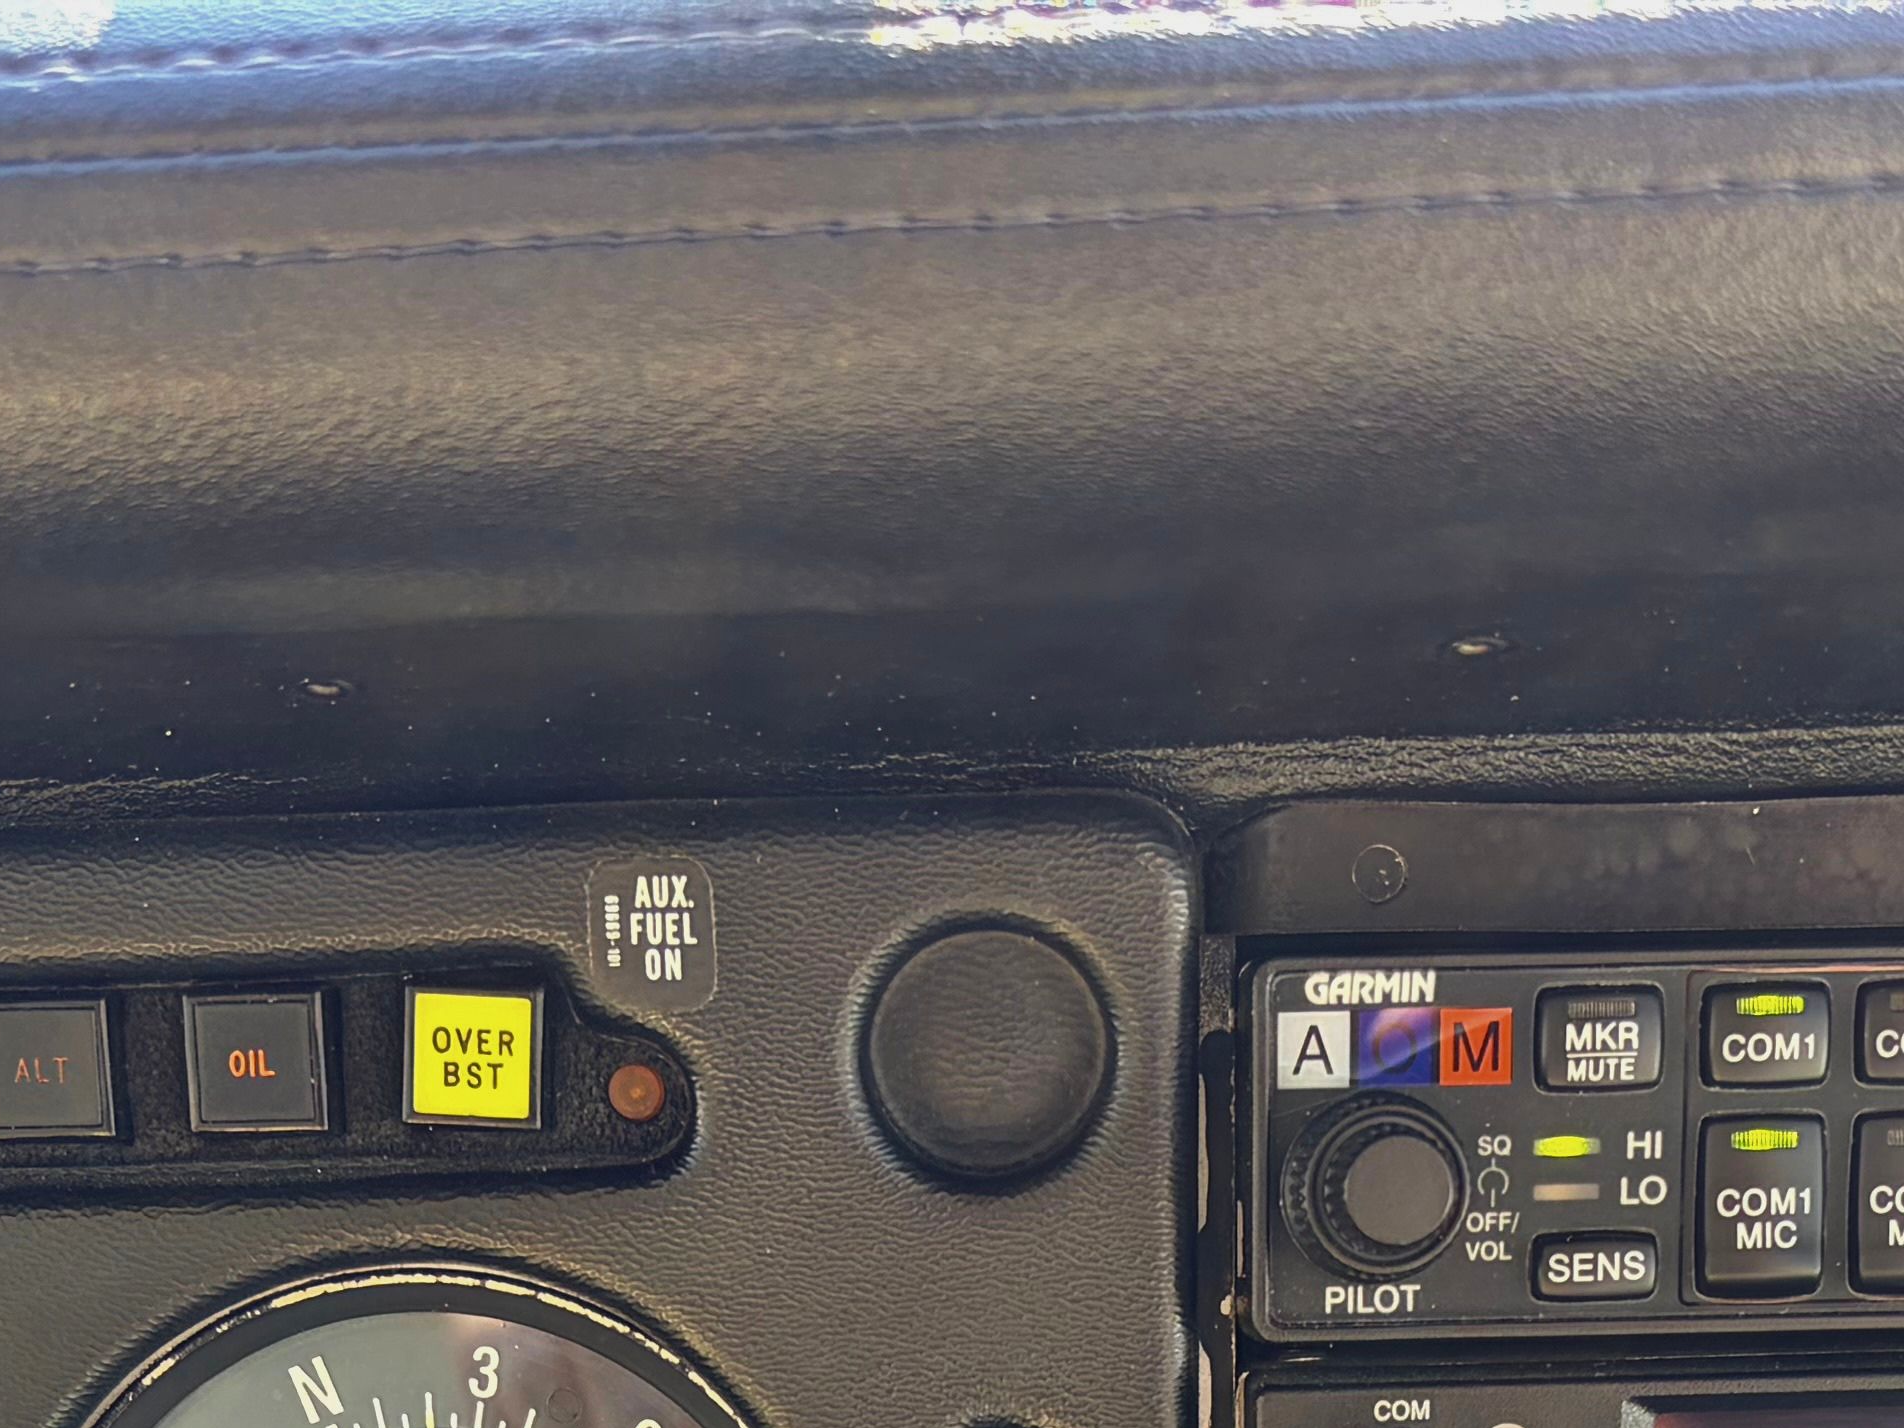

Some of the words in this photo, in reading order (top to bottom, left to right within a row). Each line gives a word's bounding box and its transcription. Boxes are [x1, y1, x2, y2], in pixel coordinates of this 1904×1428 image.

[634, 875, 696, 909] AUX.
[630, 911, 698, 945] FUEL
[644, 948, 684, 982] ON
[1304, 971, 1436, 1005] GARMIN
[432, 1025, 515, 1057] OVER
[1565, 1023, 1640, 1052] MKR
[1722, 1032, 1816, 1063] COM1
[15, 1056, 68, 1086] ALT
[228, 1049, 276, 1080] OIL
[443, 1060, 505, 1091] BST
[1567, 1057, 1636, 1082] MUTE
[1716, 1187, 1812, 1217] COM1
[1736, 1219, 1799, 1250] MIC
[1547, 1251, 1647, 1284] SENS
[1323, 1284, 1422, 1316] PILOT
